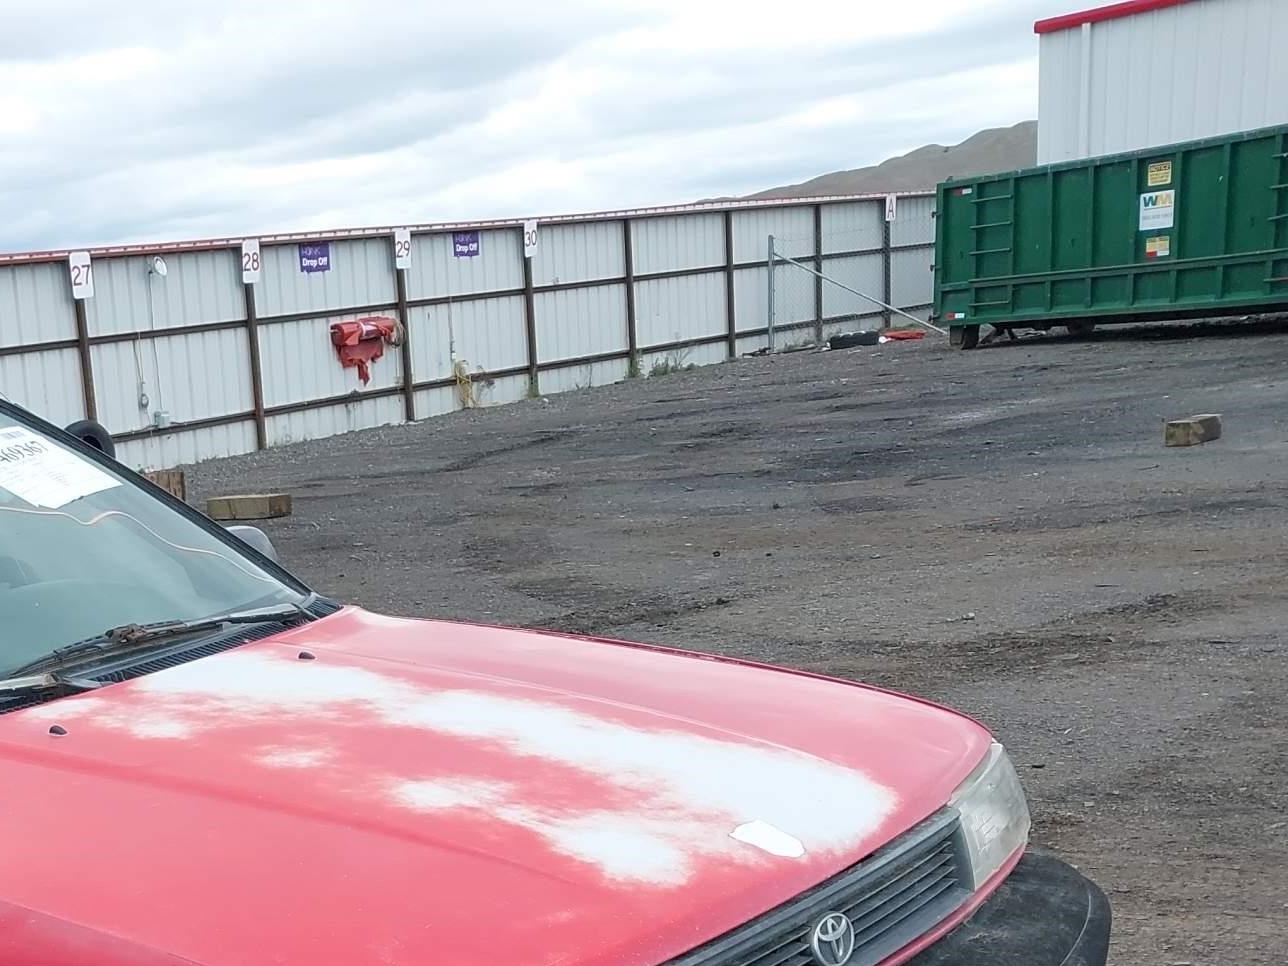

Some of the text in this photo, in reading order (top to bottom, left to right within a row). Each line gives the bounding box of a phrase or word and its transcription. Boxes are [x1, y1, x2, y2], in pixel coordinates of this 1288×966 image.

[888, 199, 894, 218] A
[1143, 193, 1172, 207] WM
[525, 230, 537, 247] 30
[396, 240, 410, 258] 29
[455, 243, 469, 254] Drop
[243, 252, 259, 271] 28
[302, 256, 328, 268] Drop Off
[72, 264, 90, 286] 27
